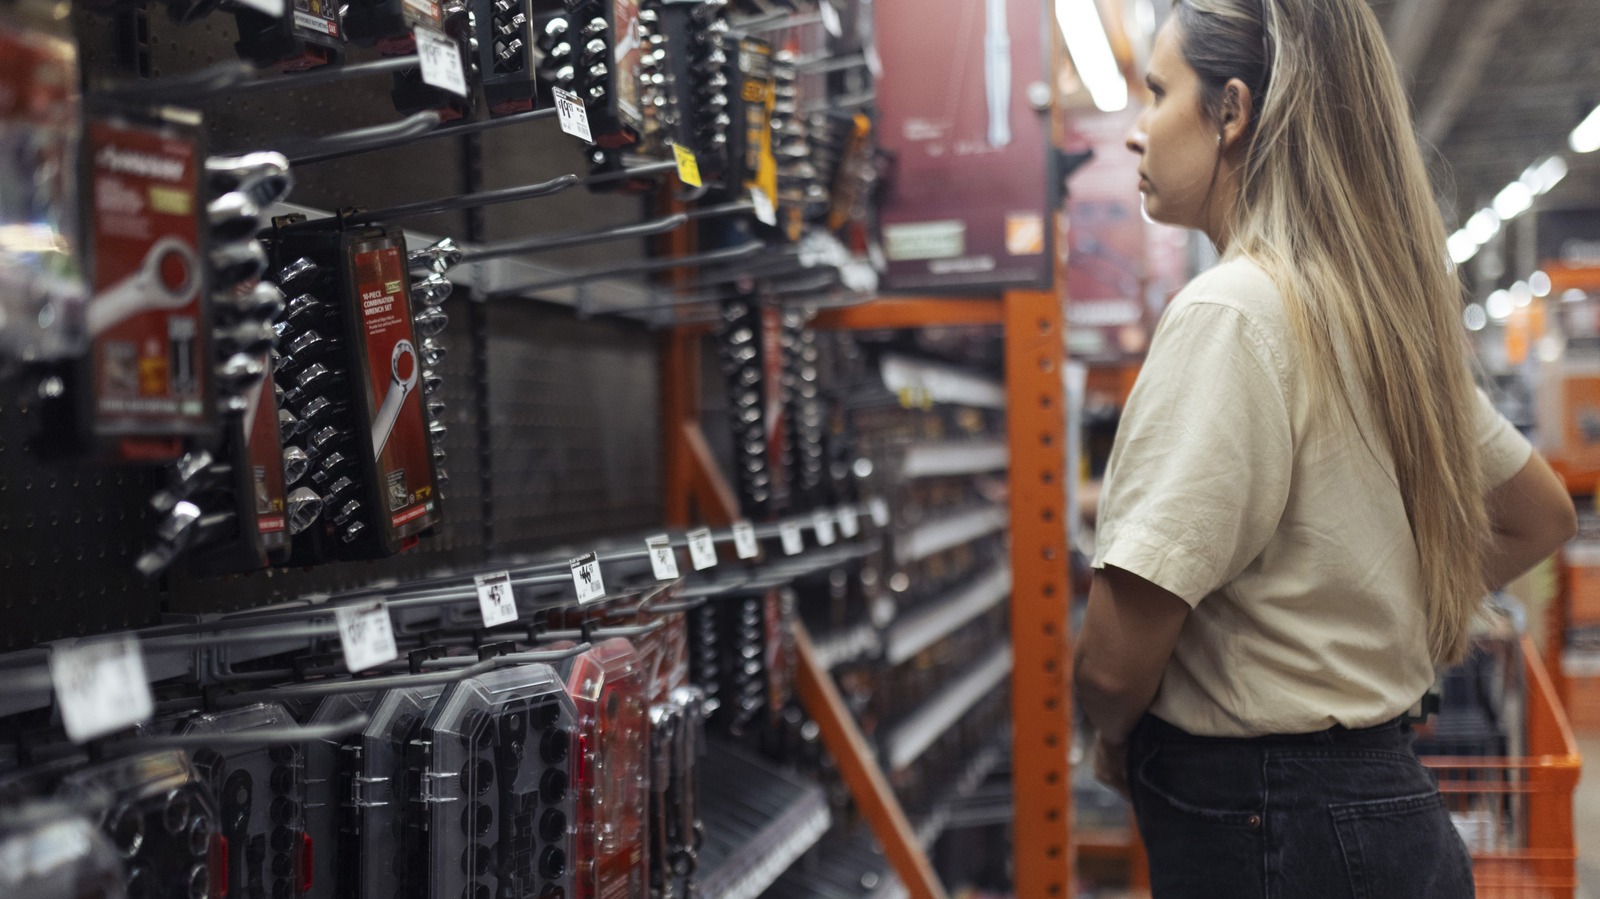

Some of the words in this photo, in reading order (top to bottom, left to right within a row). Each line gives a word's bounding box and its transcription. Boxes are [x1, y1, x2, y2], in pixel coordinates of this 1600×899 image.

[363, 291, 382, 300] 10-PIECE
[364, 296, 394, 308] COMBINATION
[365, 306, 384, 316] WRENCH
